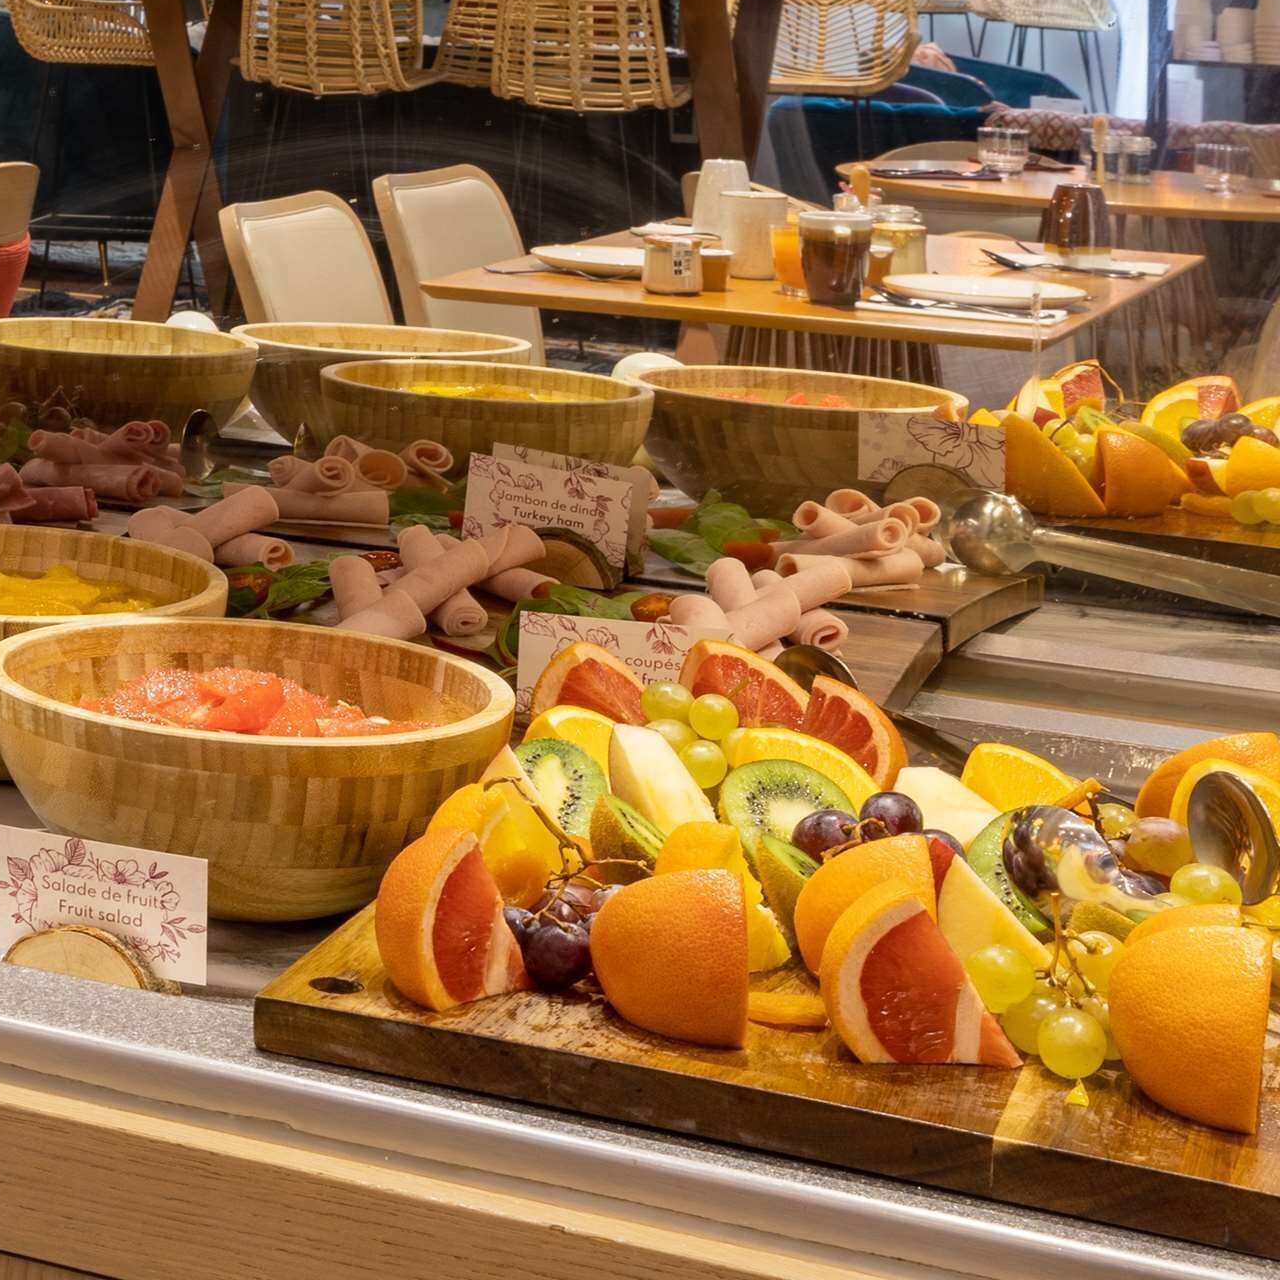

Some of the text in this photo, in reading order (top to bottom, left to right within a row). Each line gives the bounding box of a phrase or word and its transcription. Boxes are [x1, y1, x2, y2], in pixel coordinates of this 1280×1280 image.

[498, 490, 606, 518] Jambon de dinde
[512, 506, 584, 529] Turkey ham
[624, 657, 681, 671] coupés
[41, 875, 97, 898] Salade
[101, 886, 122, 902] de
[59, 899, 143, 927] Fruit salad
